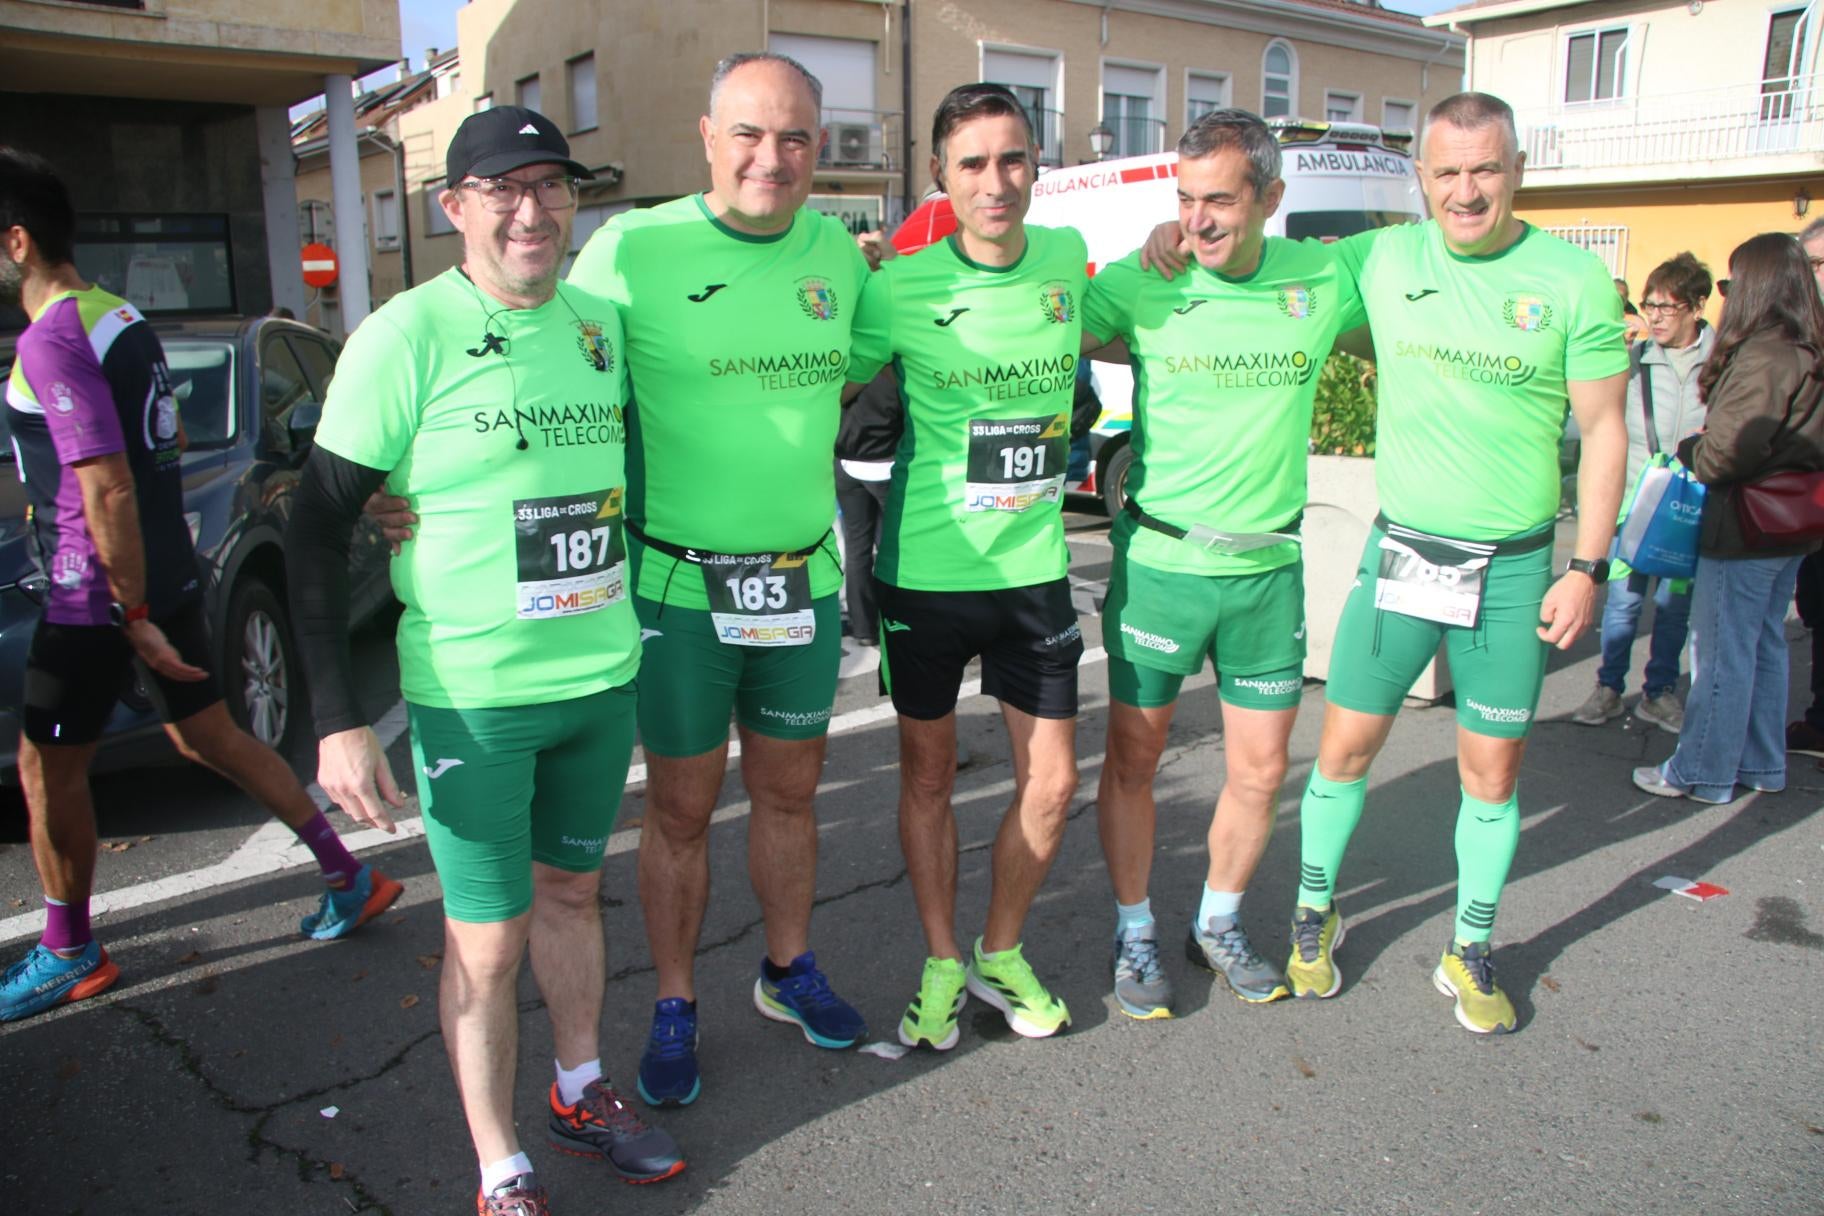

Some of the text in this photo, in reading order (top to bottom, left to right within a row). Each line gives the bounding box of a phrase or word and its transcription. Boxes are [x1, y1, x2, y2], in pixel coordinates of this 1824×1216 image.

[1297, 153, 1409, 176] AMBULANCIA
[709, 349, 842, 377] SANMAXIMO
[1165, 351, 1307, 374] SANMAXIMO
[1395, 340, 1522, 372] SANMAXIMO
[758, 369, 833, 391] TELECOM
[933, 353, 1074, 390] SANMAXIMO
[1213, 371, 1298, 389] TELECOM
[1434, 362, 1510, 386] TELECOM
[984, 375, 1068, 402] TELECOM
[474, 403, 622, 433] SANMAXIMO
[972, 425, 985, 436] 33
[986, 425, 1006, 436] LIGA
[1013, 424, 1041, 435] CROSS
[540, 425, 620, 447] TELECOM
[1000, 445, 1046, 479] 191
[969, 486, 1057, 508] JOMISAA
[517, 507, 533, 520] 33
[534, 506, 559, 520] LIGA
[568, 501, 598, 516] CROSS
[550, 526, 610, 572] 187
[714, 554, 736, 565] LIGA
[523, 580, 623, 612] JOMISAGA
[726, 575, 788, 611] 183
[721, 625, 813, 640] JOMISAGA
[1120, 623, 1173, 647] SANMAXIMO
[35, 959, 96, 993] MERRELL
